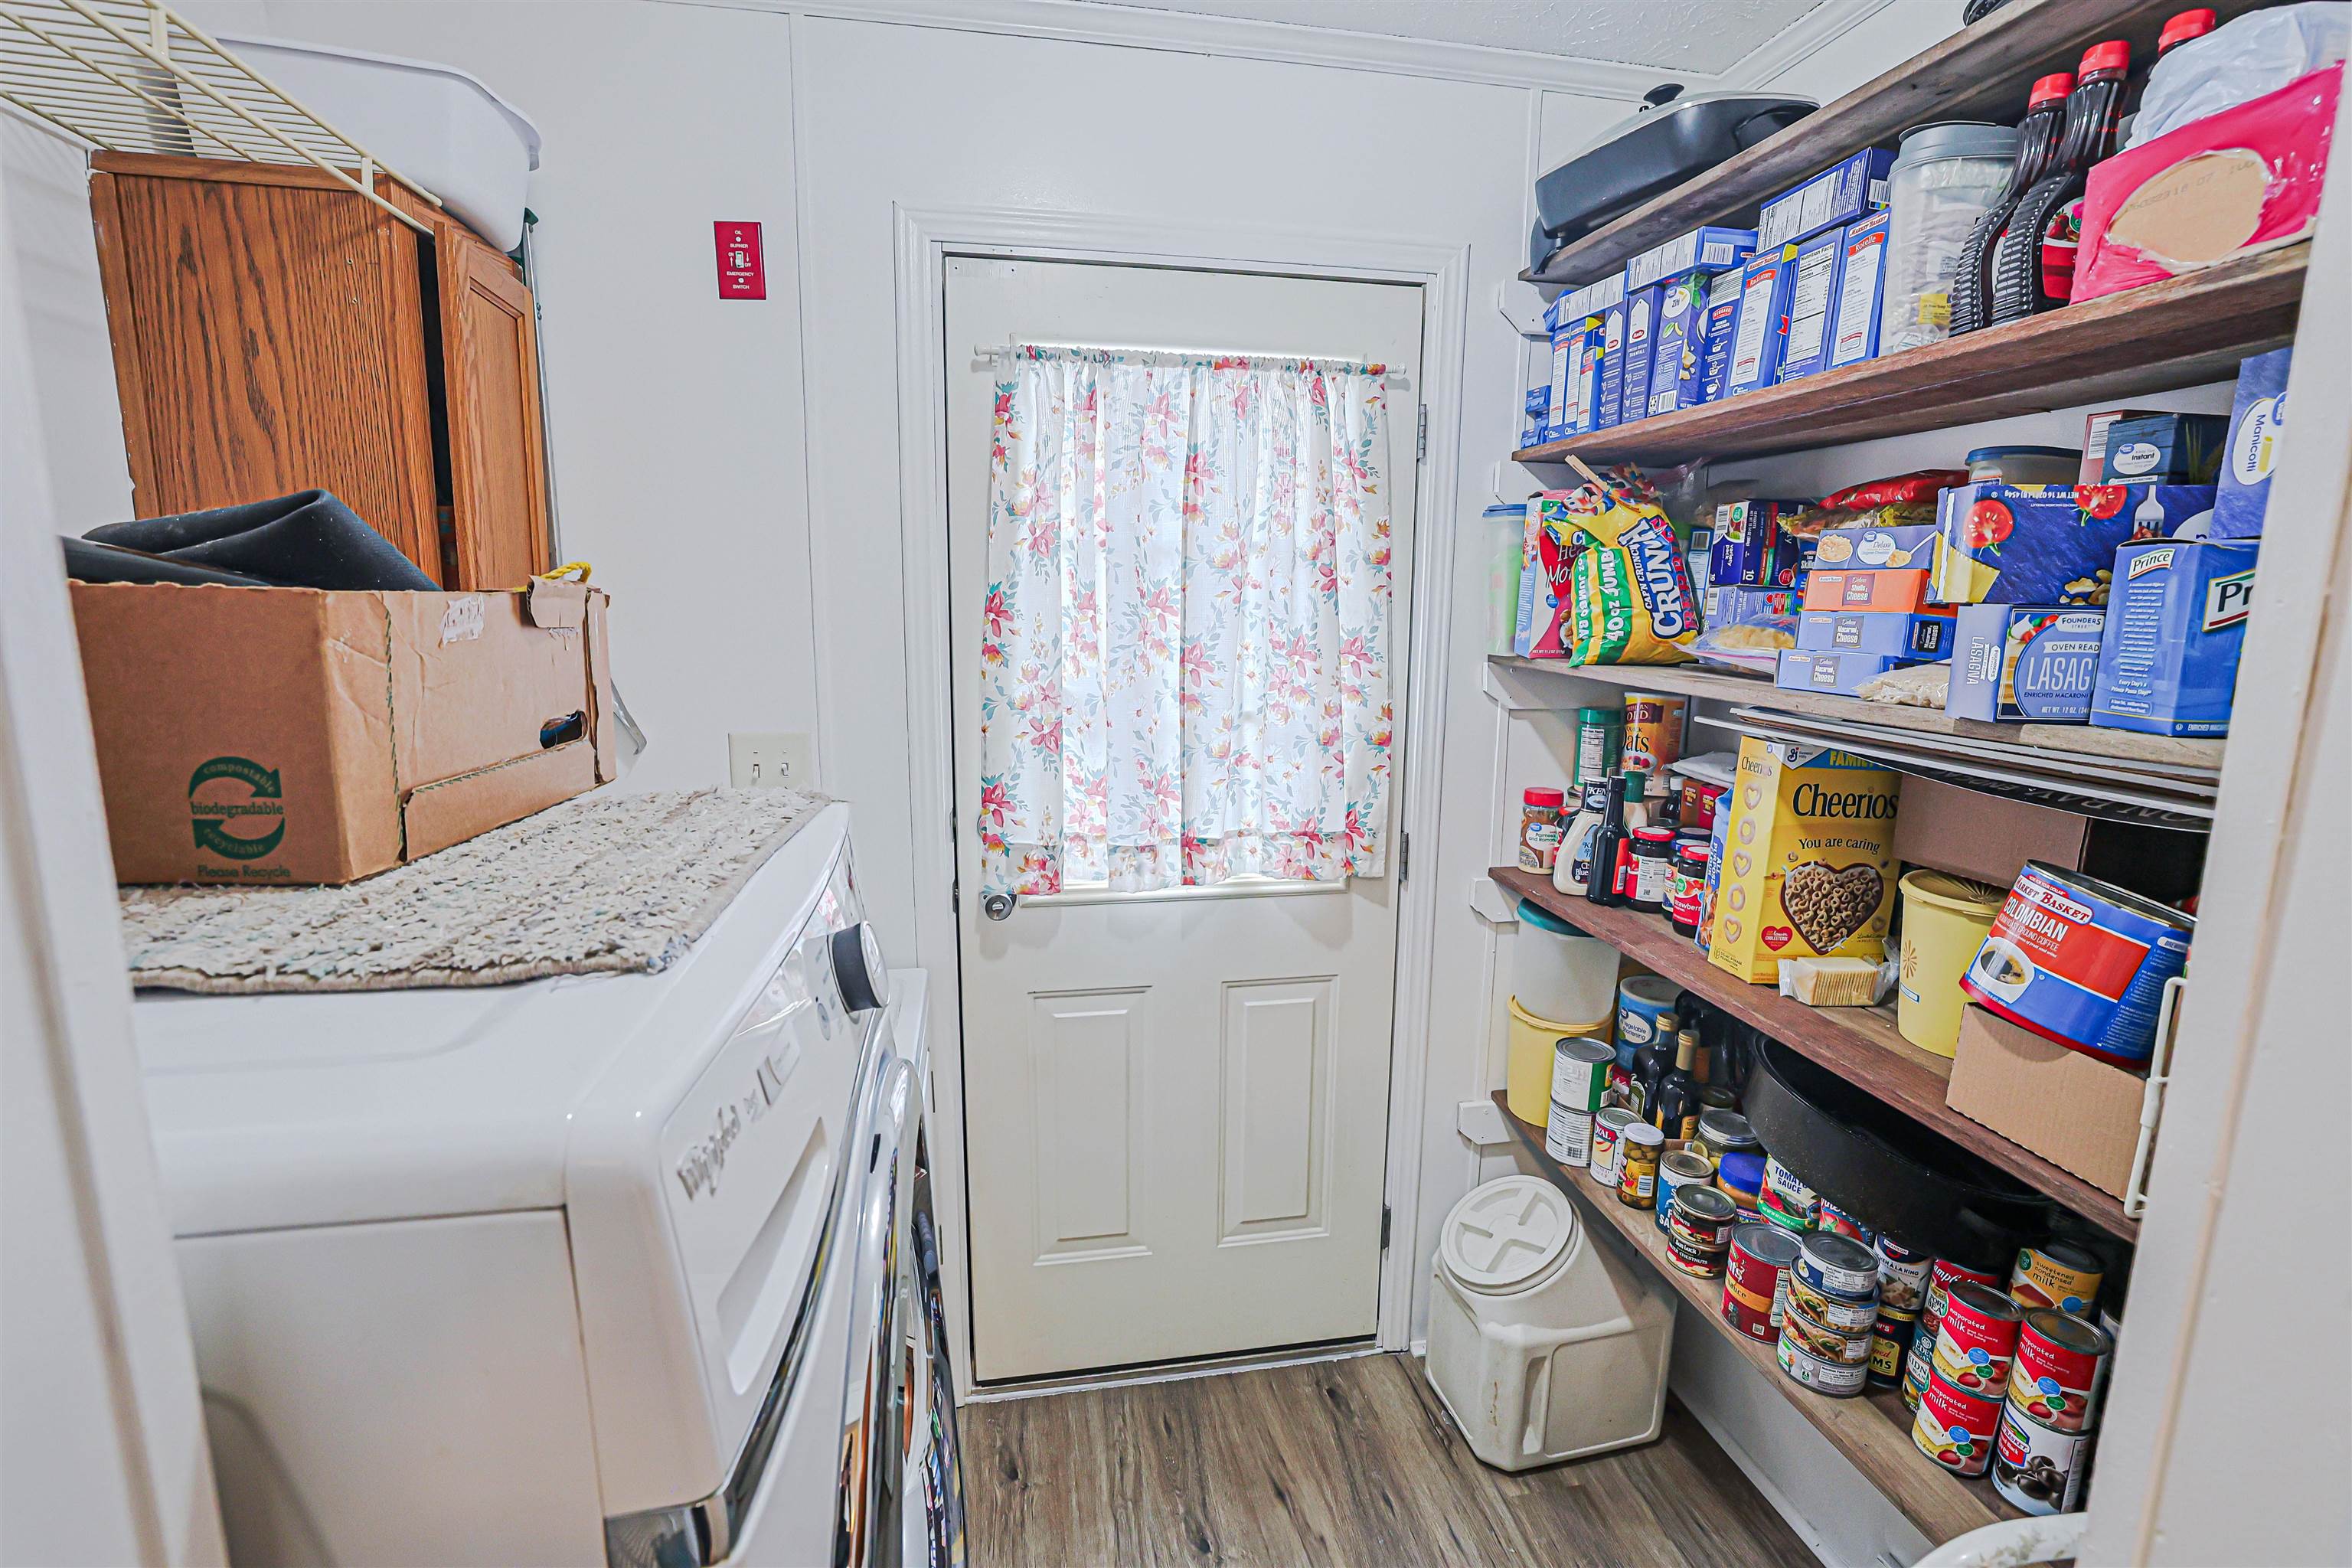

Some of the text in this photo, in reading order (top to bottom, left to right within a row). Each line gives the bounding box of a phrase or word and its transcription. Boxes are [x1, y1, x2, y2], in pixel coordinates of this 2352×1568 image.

[1855, 236, 1877, 253] Rotelle
[2246, 413, 2267, 472] Manicotti
[2132, 551, 2171, 572] Prince
[1846, 591, 1869, 601] Cheese
[2062, 616, 2102, 626] FOUNDERS
[1836, 633, 1858, 643] Cheese
[1966, 636, 1985, 685] LASAGNA
[1813, 672, 1834, 683] Cheese
[2026, 657, 2099, 691] LASAG
[1626, 710, 1649, 720] OLD
[203, 763, 276, 794] compostable
[190, 801, 285, 818] biodegradable
[1792, 782, 1899, 820] Cheerios
[1799, 837, 1880, 855] You are caring
[197, 864, 291, 879] Please Recycle
[2040, 890, 2090, 922] BASKET
[2004, 897, 2069, 942] COLOMBIAN
[2037, 936, 2060, 952] COFFEE
[1594, 1124, 1611, 1140] OYAL
[1777, 1178, 1802, 1194] SAUCE
[1884, 1240, 1908, 1255] SWANSON
[1679, 1251, 1708, 1265] CHESTNUTS
[2034, 1266, 2073, 1285] condensed
[2036, 1261, 2075, 1281] sweetened
[2033, 1272, 2055, 1289] milk
[1947, 1315, 1965, 1333] milk
[1949, 1307, 1985, 1331] evaporated
[2019, 1340, 2035, 1361] milk
[2020, 1333, 2055, 1361] evaporated
[1929, 1392, 1947, 1411] milk
[1931, 1383, 1968, 1410] evaporated
